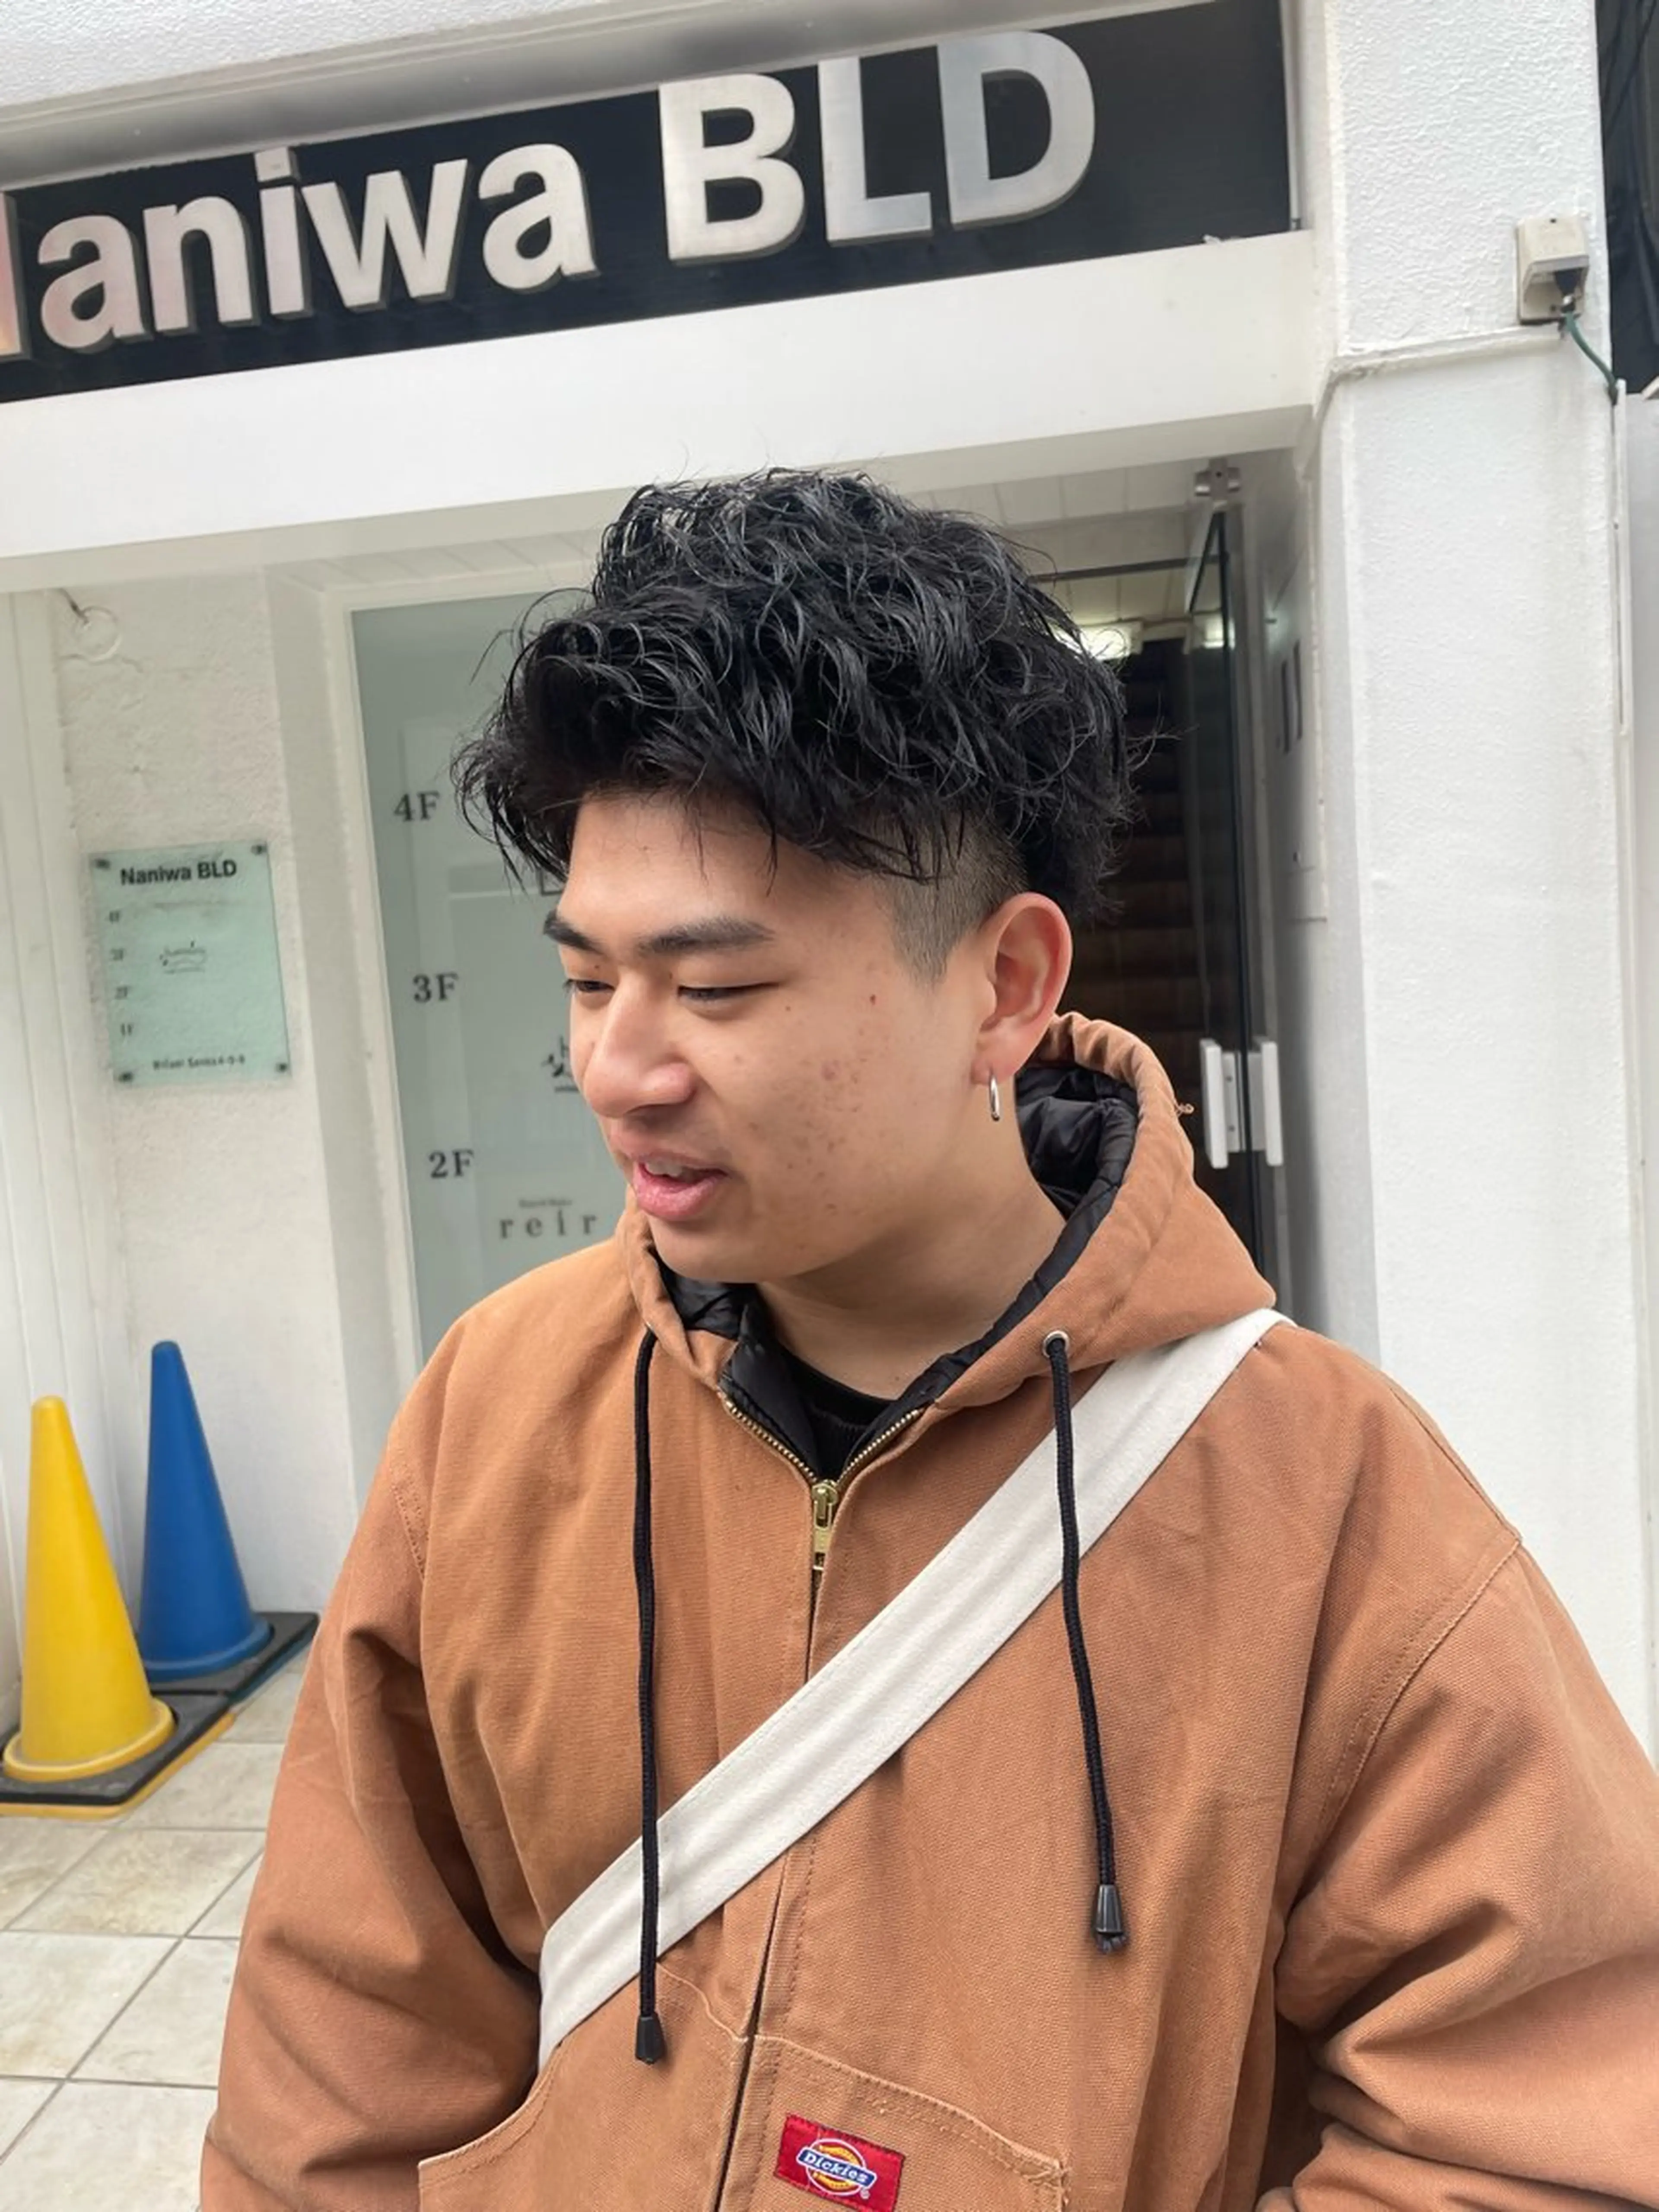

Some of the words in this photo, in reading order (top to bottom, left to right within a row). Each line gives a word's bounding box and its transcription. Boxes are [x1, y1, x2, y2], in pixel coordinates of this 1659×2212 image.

[659, 30, 1096, 261] BLD
[393, 790, 441, 822] 4F
[120, 865, 191, 885] Naniwa
[197, 859, 237, 879] BLD
[413, 973, 458, 1003] 3F
[429, 1149, 474, 1179] 2F
[804, 2152, 869, 2183] Dickies
